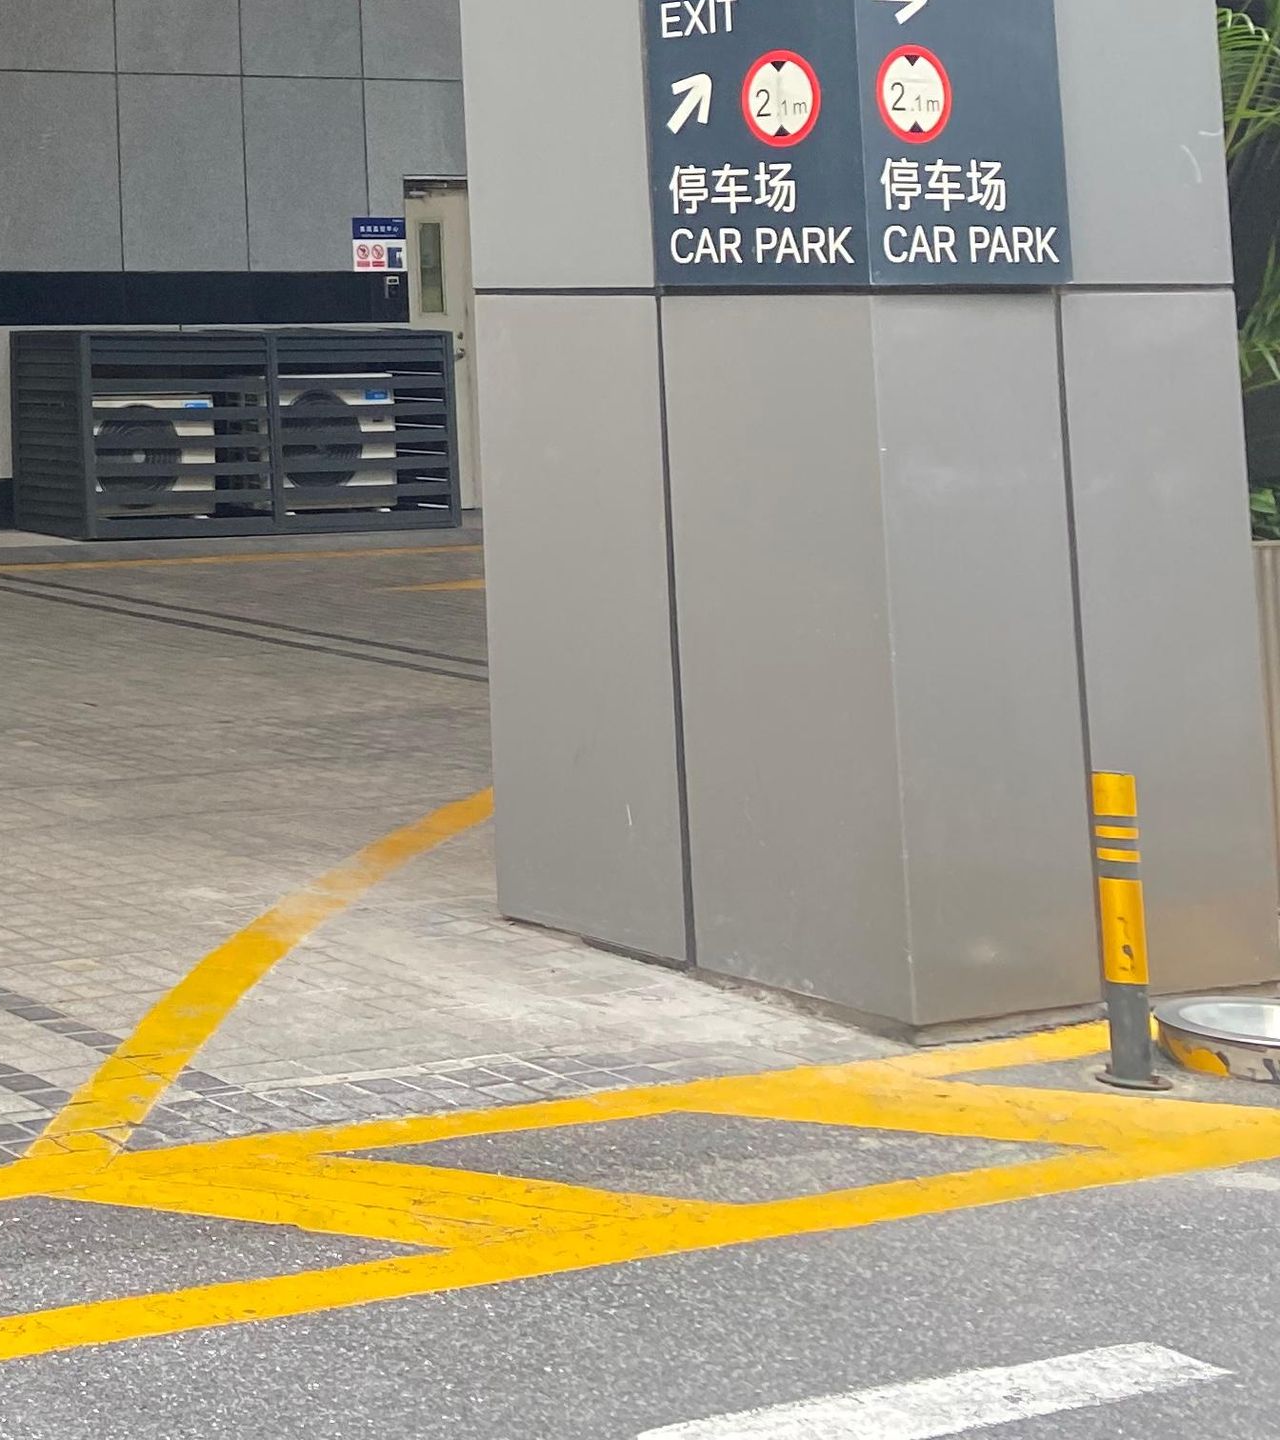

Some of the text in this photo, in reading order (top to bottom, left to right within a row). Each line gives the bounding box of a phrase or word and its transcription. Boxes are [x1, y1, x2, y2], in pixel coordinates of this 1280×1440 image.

[889, 81, 940, 114] 2.1m
[669, 162, 796, 215] 停车场
[880, 157, 1007, 213] 停车场
[670, 225, 855, 265] CAR PARK
[883, 225, 1060, 264] CAR PARK
